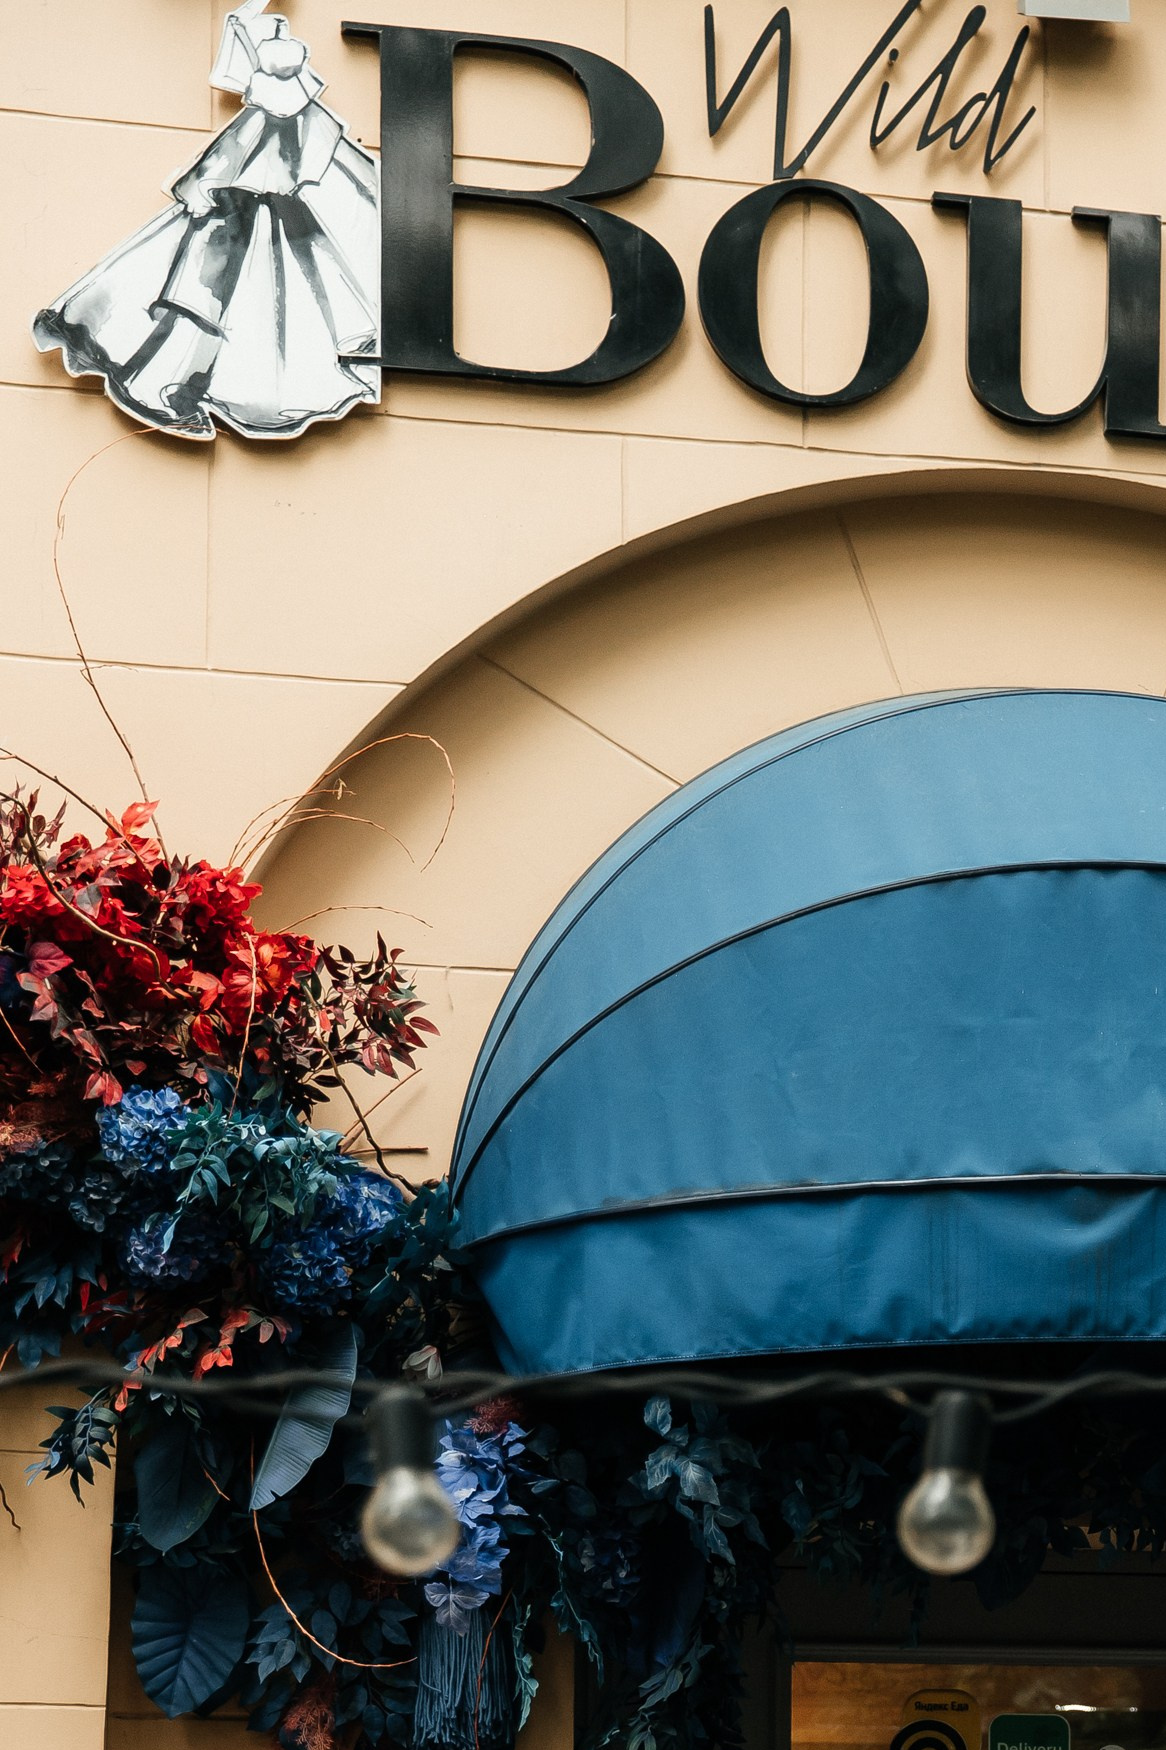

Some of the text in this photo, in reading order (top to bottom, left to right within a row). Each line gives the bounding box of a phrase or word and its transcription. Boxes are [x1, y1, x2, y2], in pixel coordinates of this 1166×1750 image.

[704, 0, 1037, 180] Wild
[914, 1701, 969, 1712] Яндекс Еда
